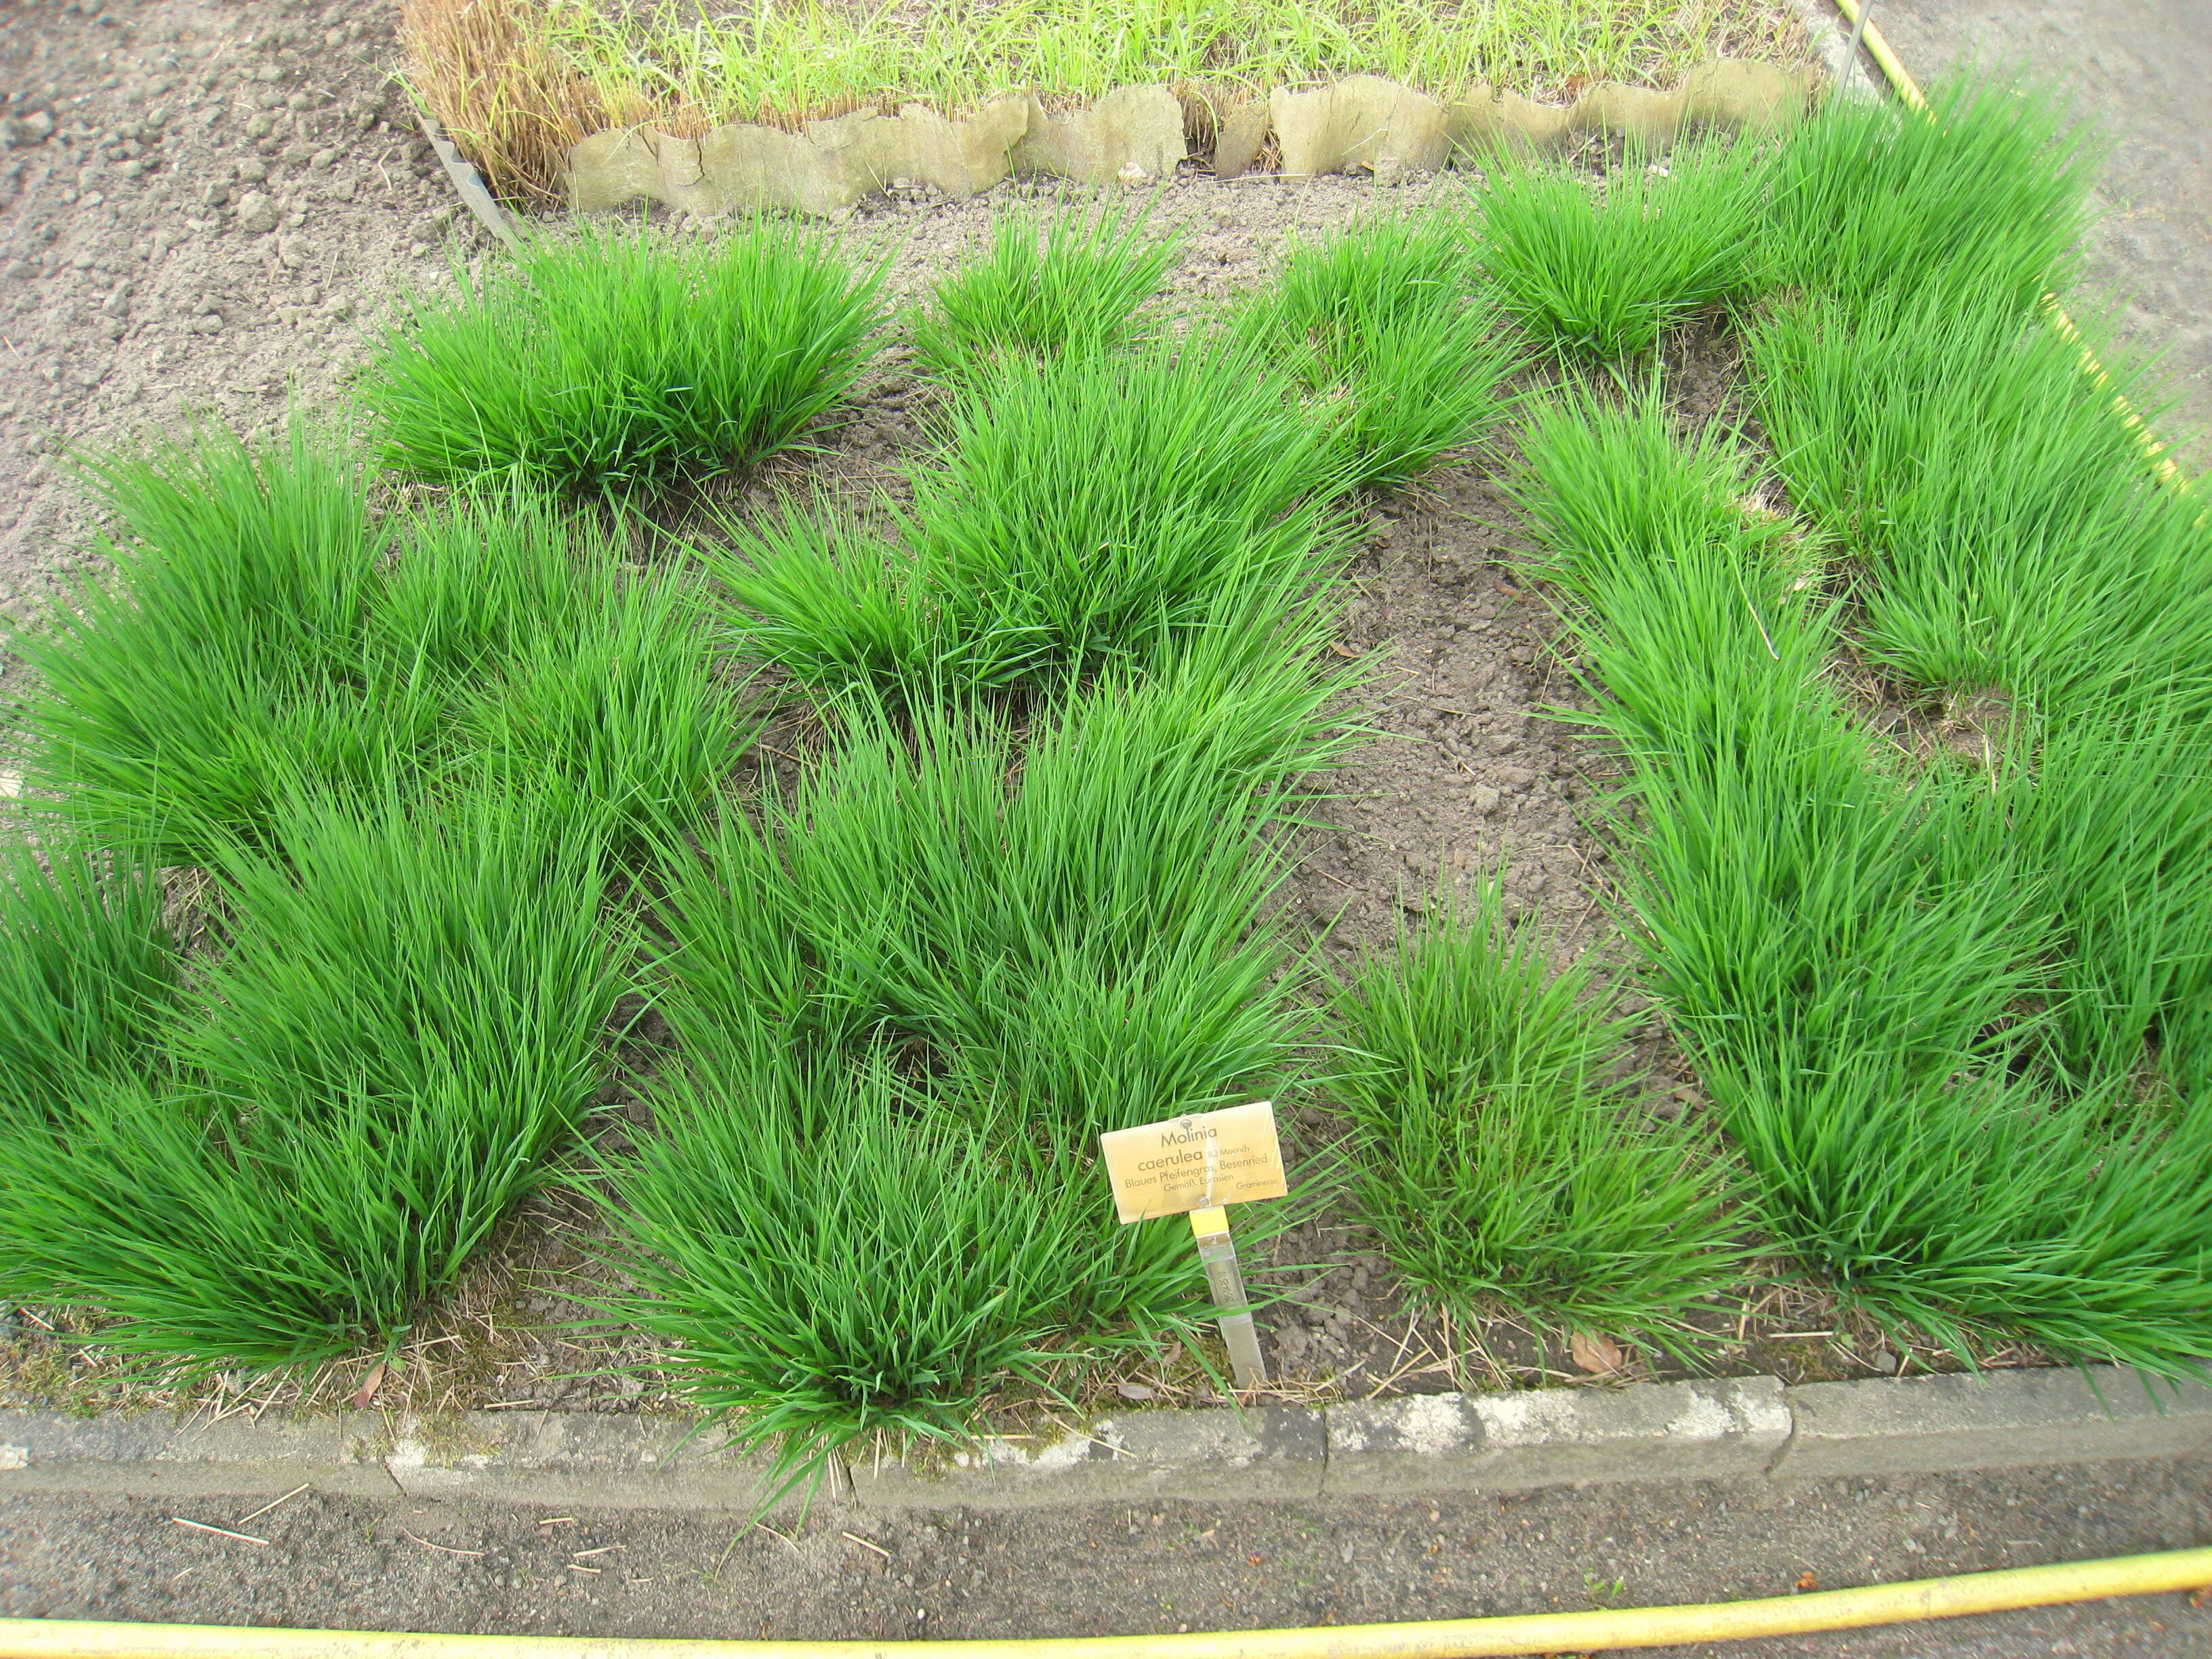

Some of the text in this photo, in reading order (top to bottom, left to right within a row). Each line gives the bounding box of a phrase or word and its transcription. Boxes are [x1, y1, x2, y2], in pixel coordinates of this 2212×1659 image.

[1162, 1126, 1217, 1147] Molinia
[1138, 1149, 1203, 1171] caerulea
[1125, 1153, 1268, 1189] Blaues Pfeifengras, Besenried
[1164, 1173, 1234, 1191] Gemäß. Eurasien
[1235, 1179, 1278, 1190] Gramineae
